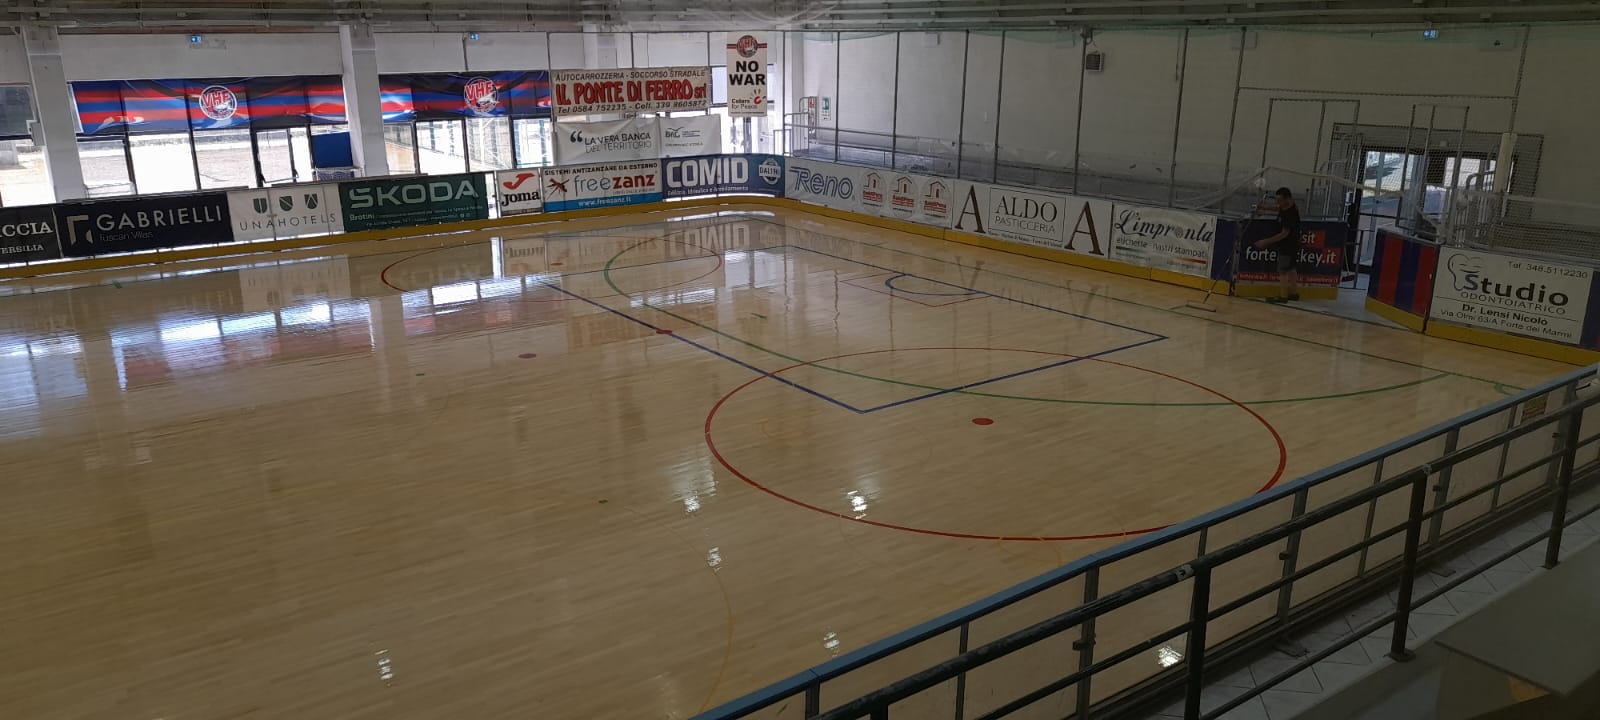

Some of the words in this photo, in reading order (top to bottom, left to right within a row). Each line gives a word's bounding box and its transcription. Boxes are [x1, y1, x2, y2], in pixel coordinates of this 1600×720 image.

[556, 72, 625, 82] AUTOCARROZZERIA
[630, 71, 668, 79] SOCCORSO
[670, 70, 706, 78] STRADALE
[736, 61, 759, 73] NO
[729, 74, 766, 86] WAR
[202, 90, 231, 108] VHF
[465, 80, 493, 102] VHF
[556, 84, 571, 106] IL
[574, 80, 625, 105] PONTE
[627, 80, 642, 103] DI
[645, 79, 694, 101] FERRO
[694, 83, 707, 99] srl
[572, 104, 593, 113] 0584
[596, 103, 627, 112] 752235
[584, 136, 597, 146] LA
[598, 134, 620, 144] VERA
[622, 132, 652, 142] BANCA
[585, 144, 602, 154] DEL
[603, 140, 652, 151] TERRITORIO
[572, 165, 618, 175] ANTIZANZARE
[629, 163, 658, 171] ESTERNO
[666, 157, 749, 188] COMID
[573, 174, 656, 197] freezanz
[789, 166, 854, 200] Reno
[954, 185, 987, 234] A
[995, 195, 1058, 222] ALDO
[96, 205, 223, 231] GABRIELLI
[995, 215, 1056, 234] PASTICCERIA
[0, 221, 53, 239] CCIA
[130, 230, 154, 241] Villas
[1064, 201, 1105, 256] A
[1300, 231, 1316, 244] sit
[0, 244, 45, 255] ERSILIA
[1116, 237, 1148, 248] etichette
[1152, 241, 1173, 253] nastri
[1174, 247, 1208, 258] stampati
[1526, 263, 1589, 280] 348.5112230
[1463, 273, 1569, 307] Studio
[1460, 291, 1567, 316] ODONTOIATRICO
[1462, 303, 1477, 314] Dr.
[1480, 308, 1511, 321] Lensi
[1440, 309, 1455, 318] Via
[1456, 311, 1477, 322] Olmi
[1500, 319, 1524, 331] Forte
[1526, 322, 1541, 334] dei
[1542, 326, 1573, 340] Marmi
